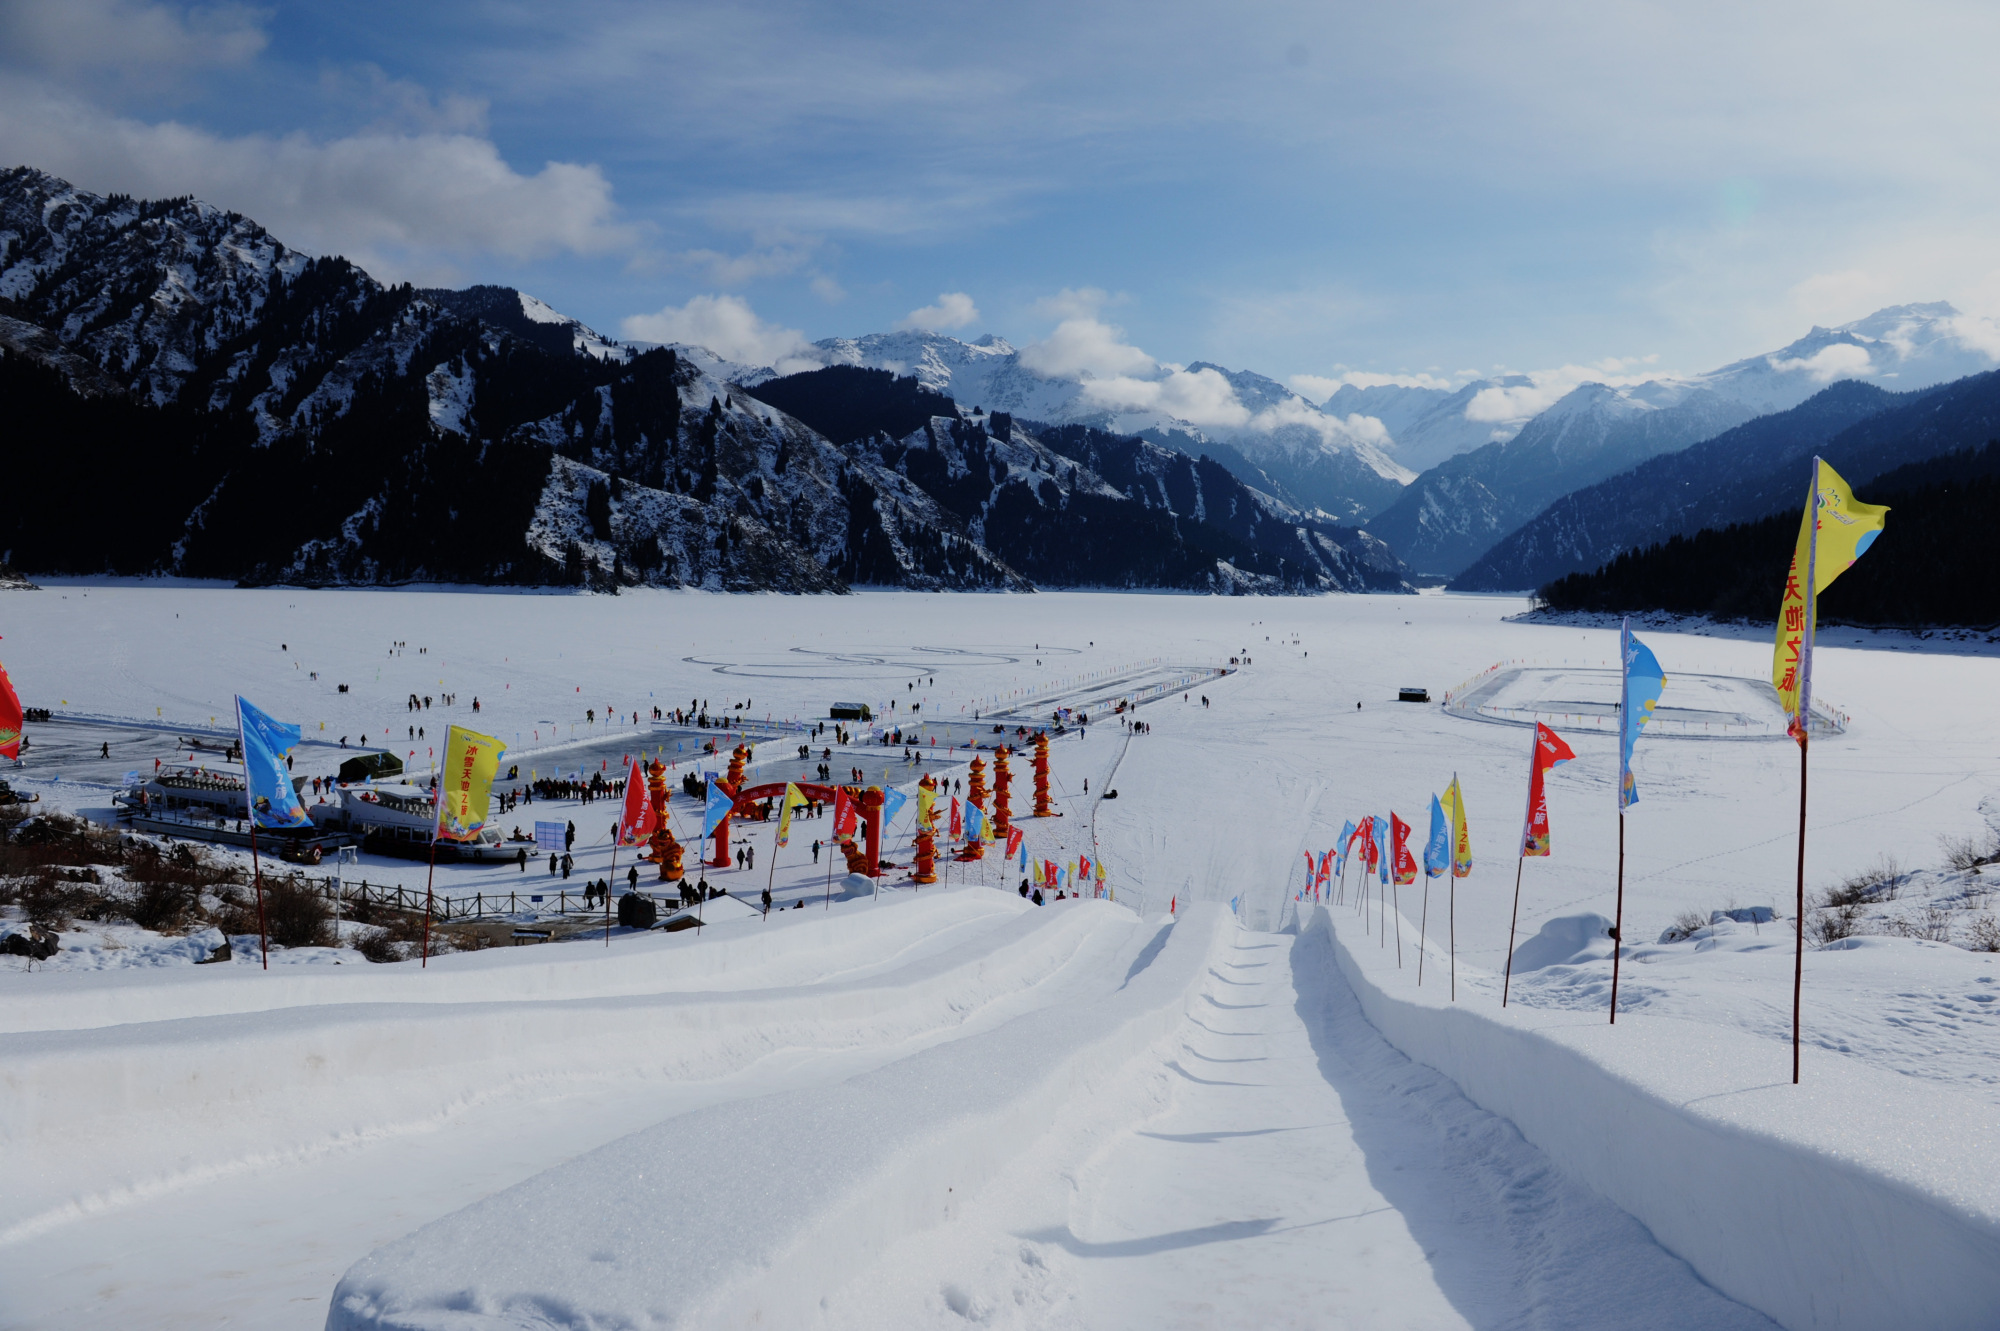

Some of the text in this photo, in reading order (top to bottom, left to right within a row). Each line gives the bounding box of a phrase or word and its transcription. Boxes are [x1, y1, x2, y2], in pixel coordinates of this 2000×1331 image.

[460, 745, 478, 816] 冰雪天池之旅
